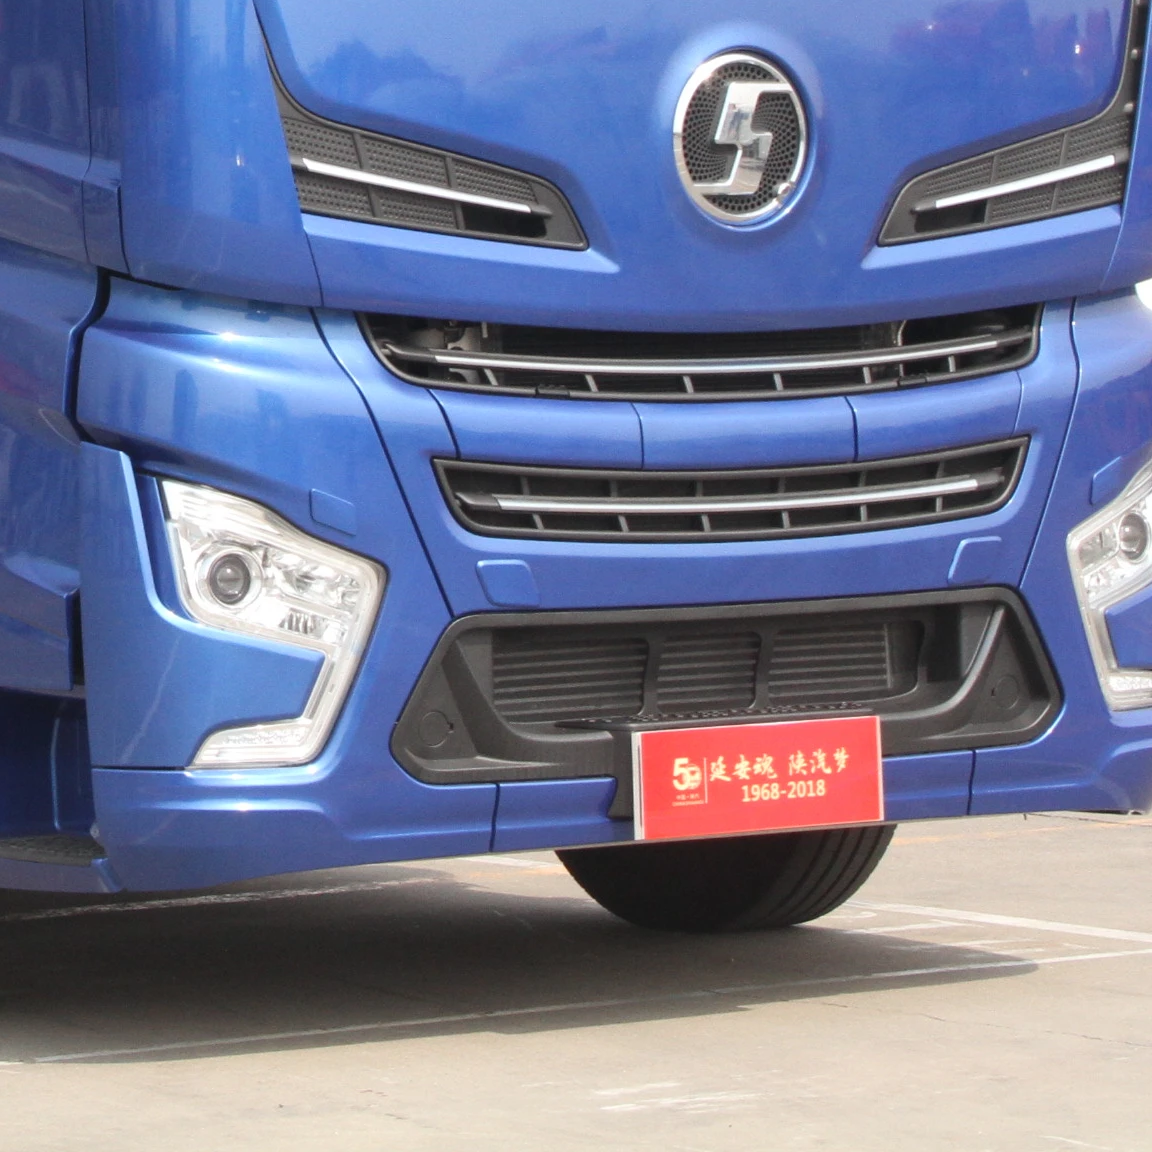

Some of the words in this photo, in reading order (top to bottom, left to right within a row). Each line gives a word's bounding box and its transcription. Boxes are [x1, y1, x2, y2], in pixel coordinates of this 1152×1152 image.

[709, 753, 778, 782] 延安魂
[741, 779, 826, 802] 1968-2018
